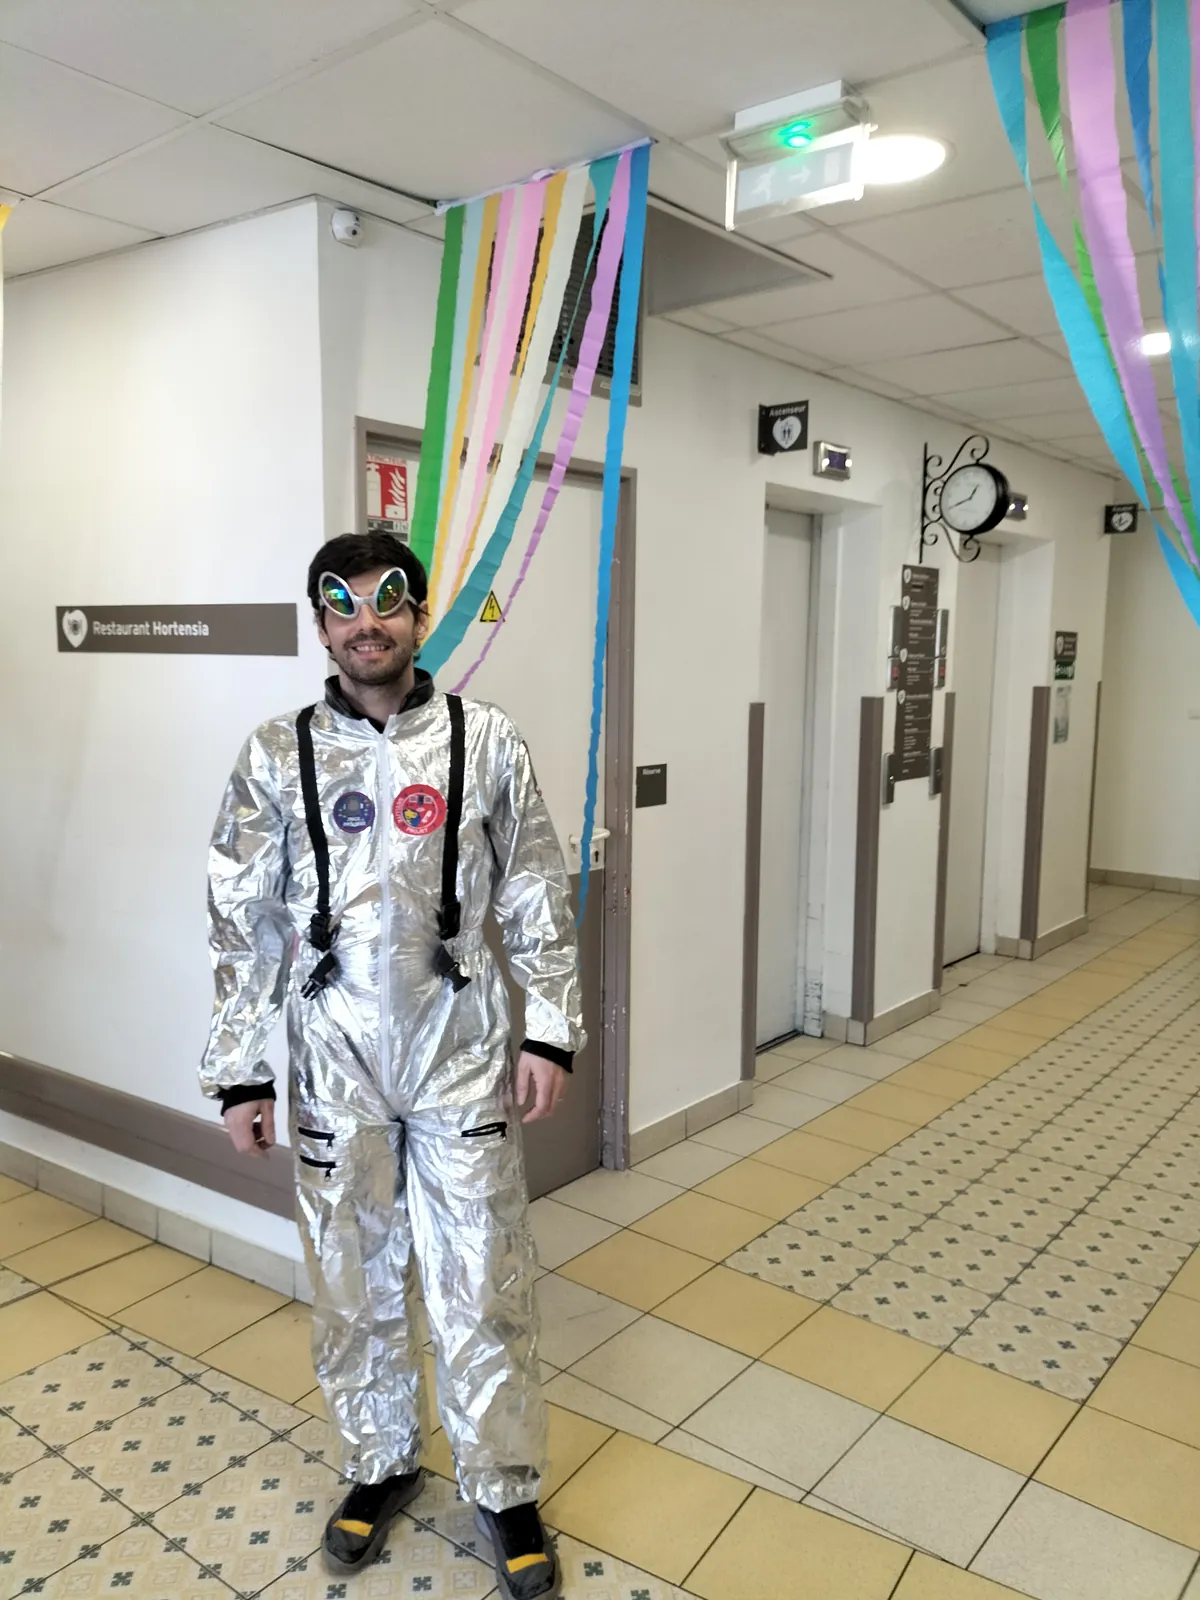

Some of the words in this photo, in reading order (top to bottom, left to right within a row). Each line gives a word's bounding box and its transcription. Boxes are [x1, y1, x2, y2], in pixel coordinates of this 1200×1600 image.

[769, 405, 806, 416] Ascenseur
[93, 621, 150, 636] Restaurant
[152, 621, 209, 636] Hortensia
